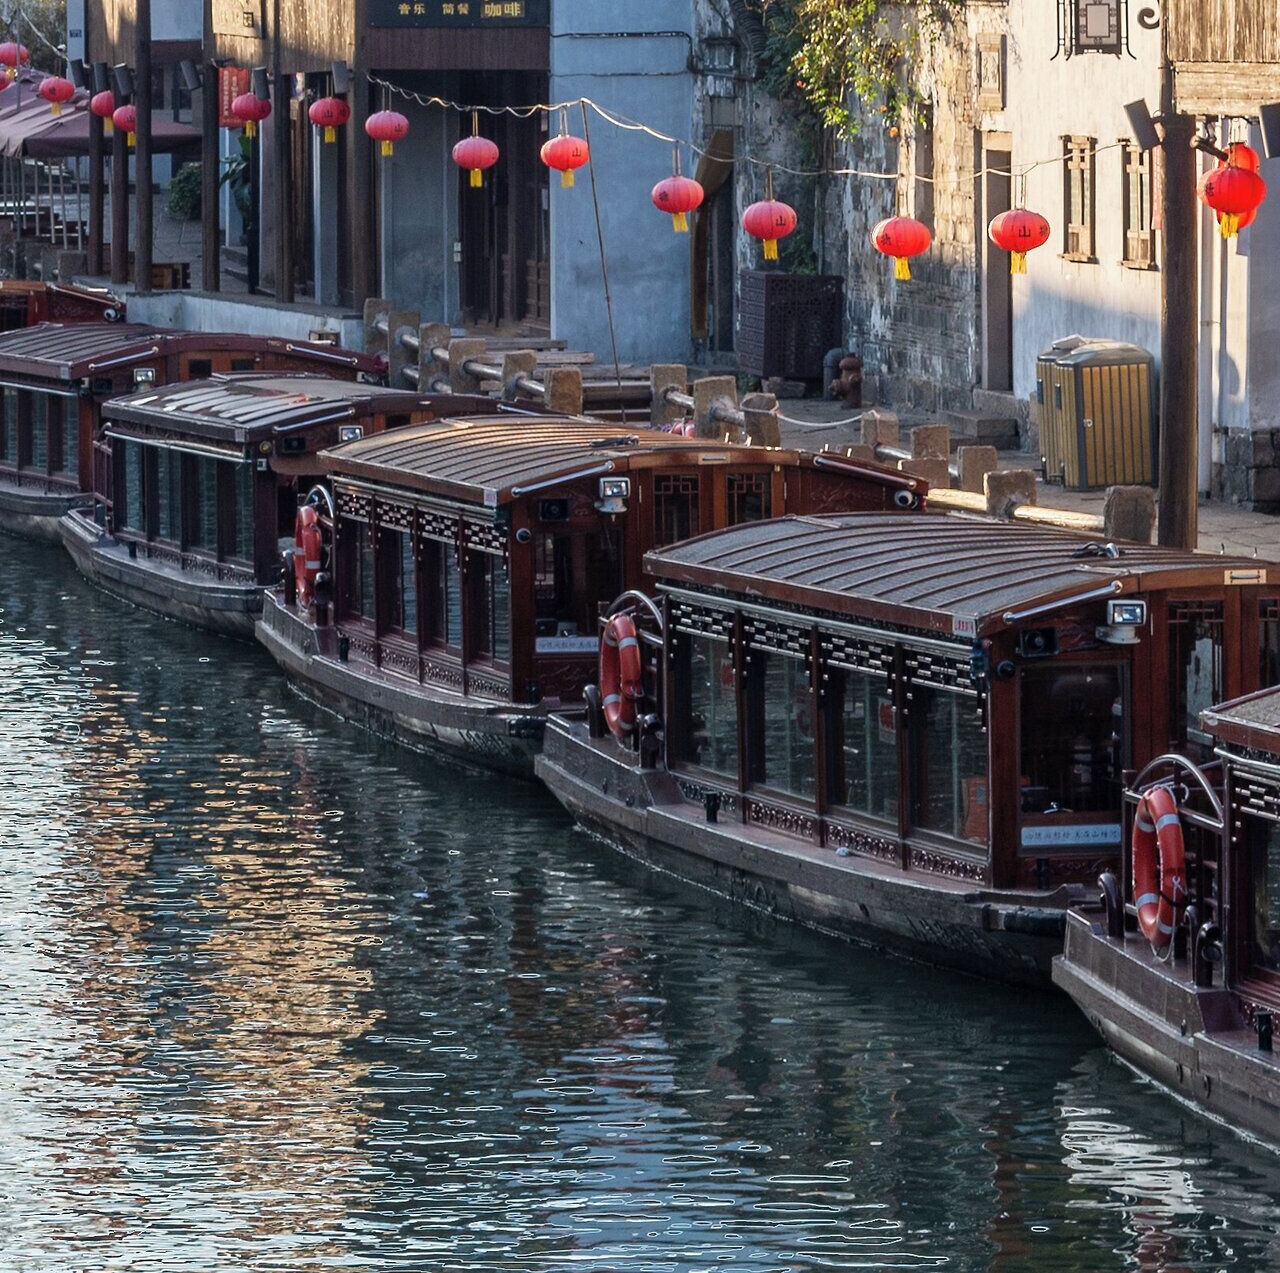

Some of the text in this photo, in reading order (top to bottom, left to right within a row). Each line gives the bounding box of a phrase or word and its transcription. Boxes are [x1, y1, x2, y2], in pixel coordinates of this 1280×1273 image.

[398, 2, 522, 17] 音乐 简餐 咖啡
[571, 147, 583, 158] 山
